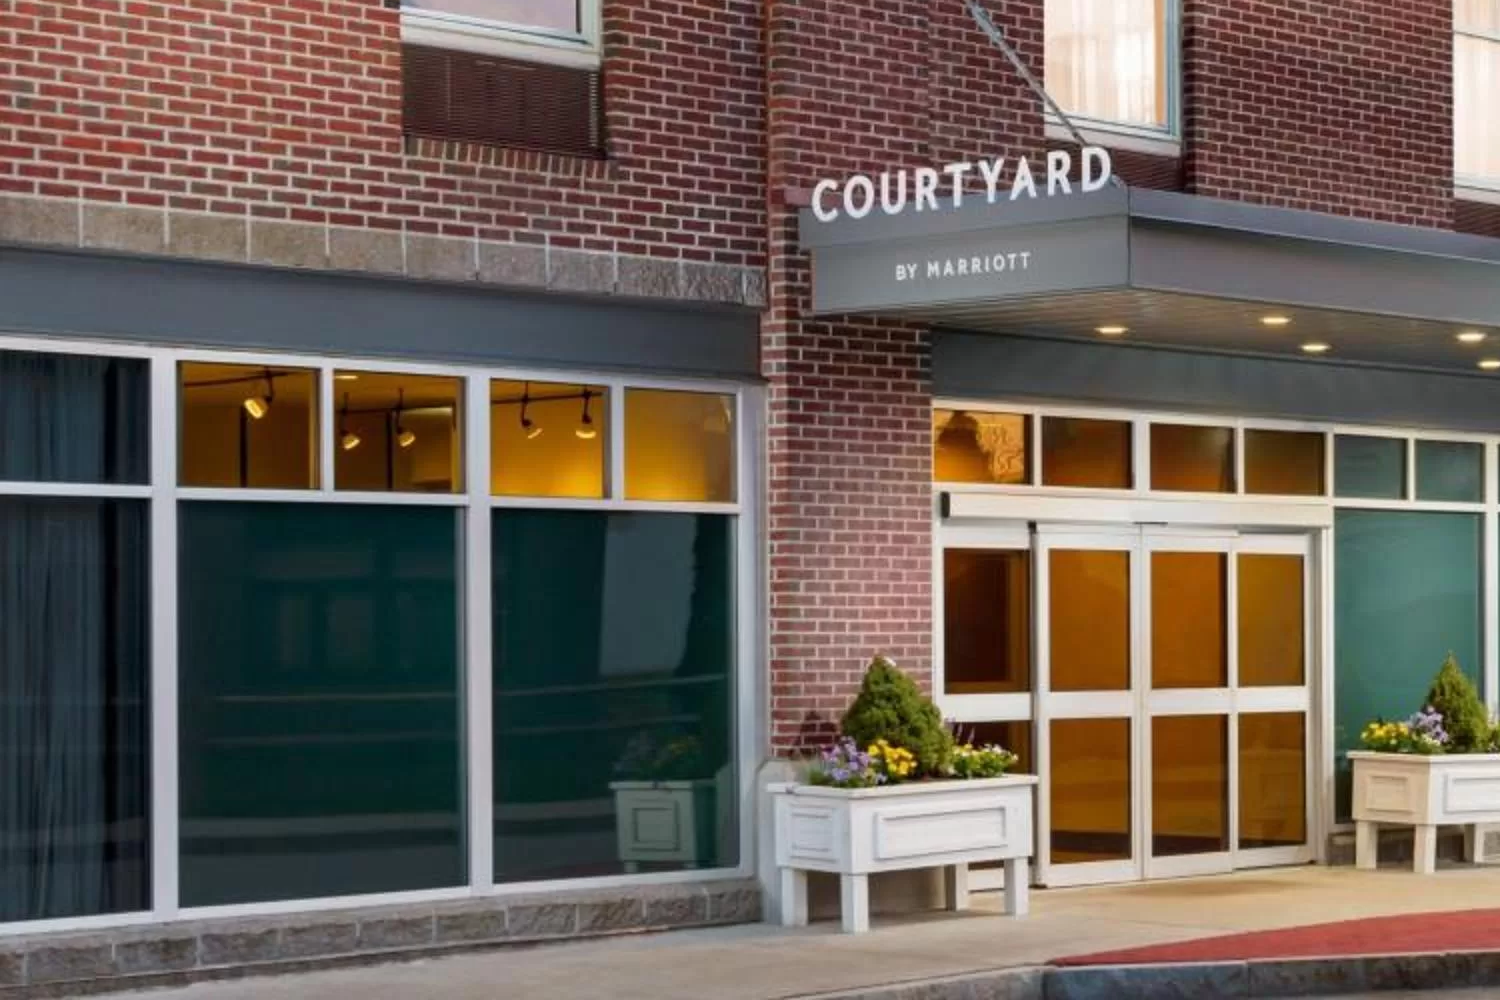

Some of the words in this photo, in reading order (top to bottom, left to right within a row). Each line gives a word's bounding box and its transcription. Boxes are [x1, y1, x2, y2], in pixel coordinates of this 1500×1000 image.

[811, 147, 1112, 222] COURTYARD
[895, 263, 918, 281] BY
[927, 252, 1031, 278] MARRIOTT
